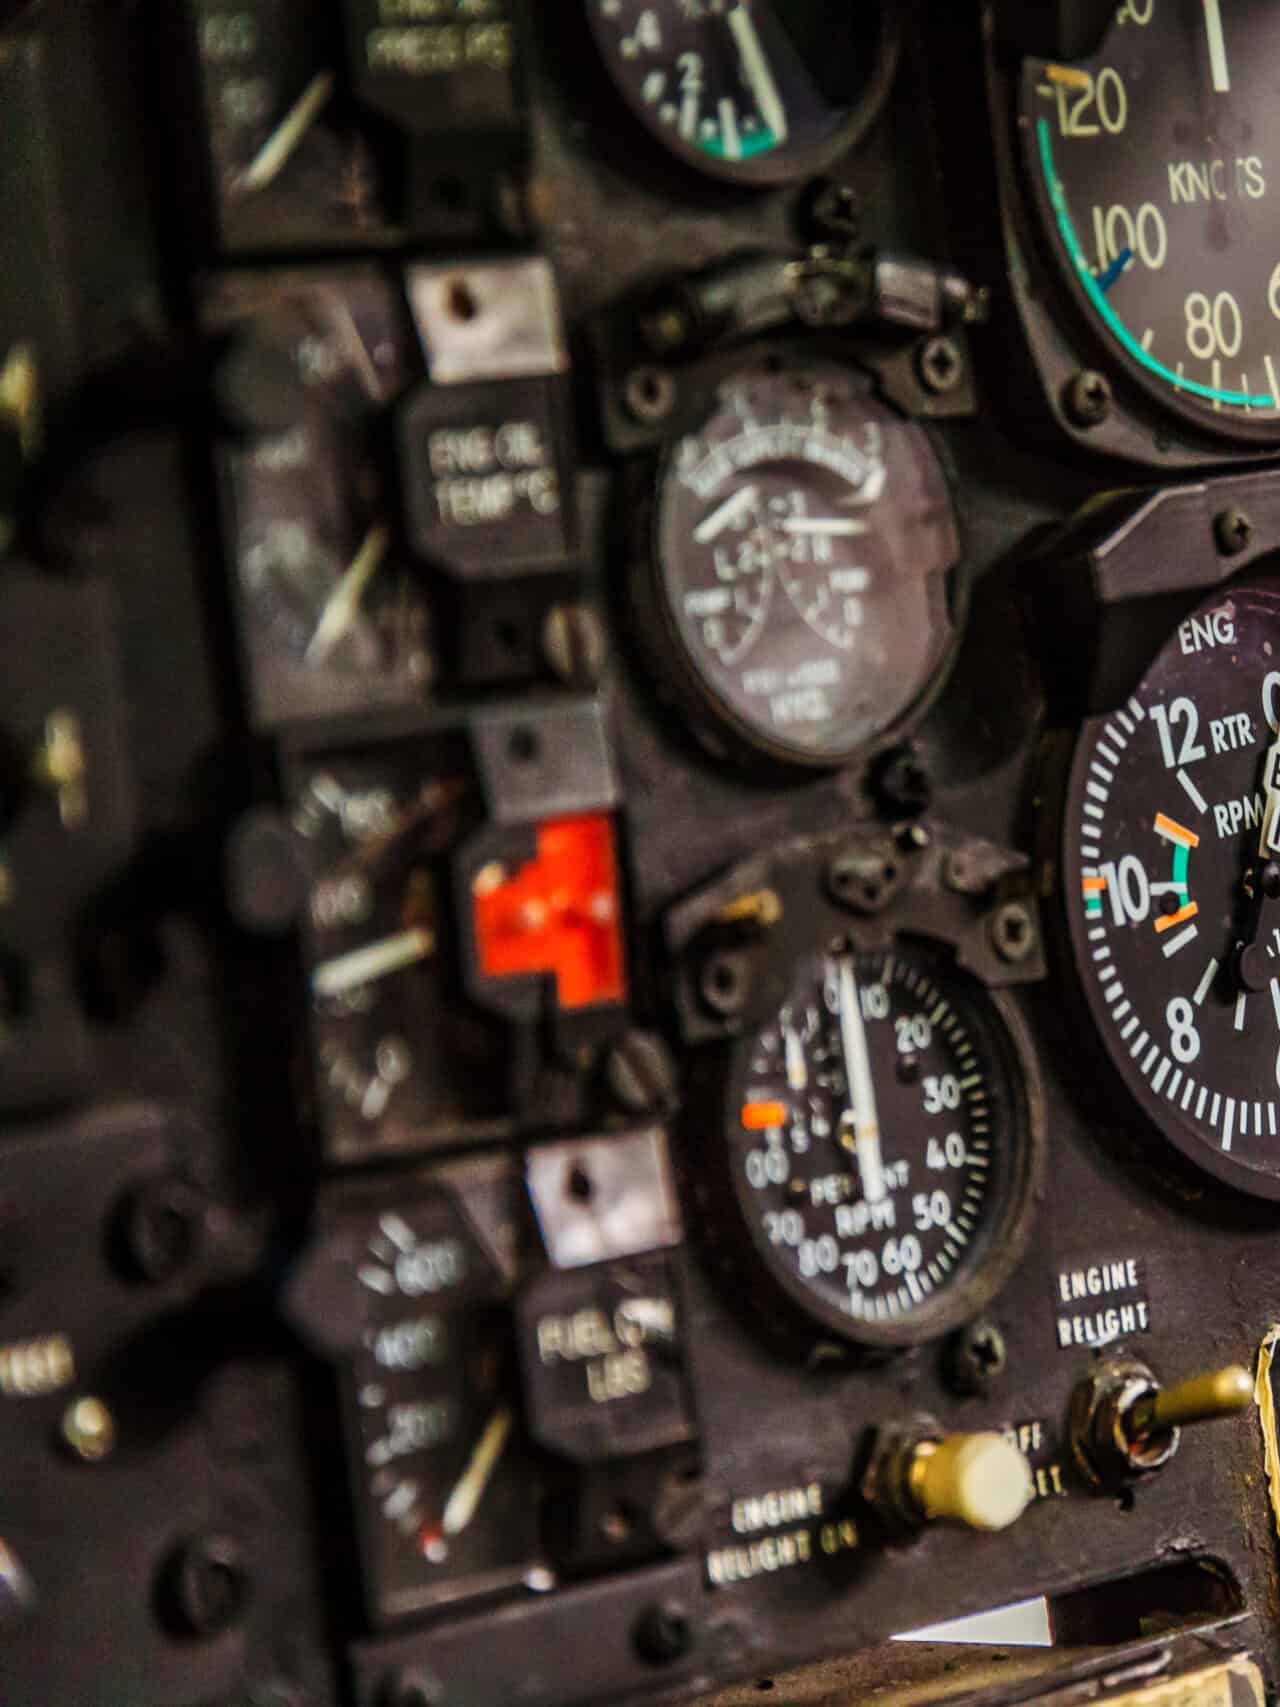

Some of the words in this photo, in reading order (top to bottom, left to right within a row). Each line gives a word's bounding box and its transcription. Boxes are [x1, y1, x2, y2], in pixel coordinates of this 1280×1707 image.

[1058, 67, 1127, 137] 120
[1093, 203, 1167, 270] 100
[1184, 292, 1242, 359] 80
[1178, 611, 1235, 655] ENG
[1150, 697, 1207, 769] 12
[1209, 712, 1256, 754] RTR
[1213, 792, 1265, 839] RPM
[1103, 855, 1151, 927] 10
[861, 982, 889, 1020] 10
[895, 1014, 931, 1053] 20
[1166, 997, 1200, 1064] 8
[922, 1074, 960, 1114] 30
[926, 1132, 965, 1169] 40
[835, 1199, 897, 1239] RPM
[912, 1190, 951, 1231] 50
[799, 1234, 839, 1277] 80
[841, 1250, 879, 1288] 70
[882, 1234, 922, 1275] 60
[1059, 1259, 1138, 1302] ENGINE
[1058, 1301, 1149, 1347] RELIGHT
